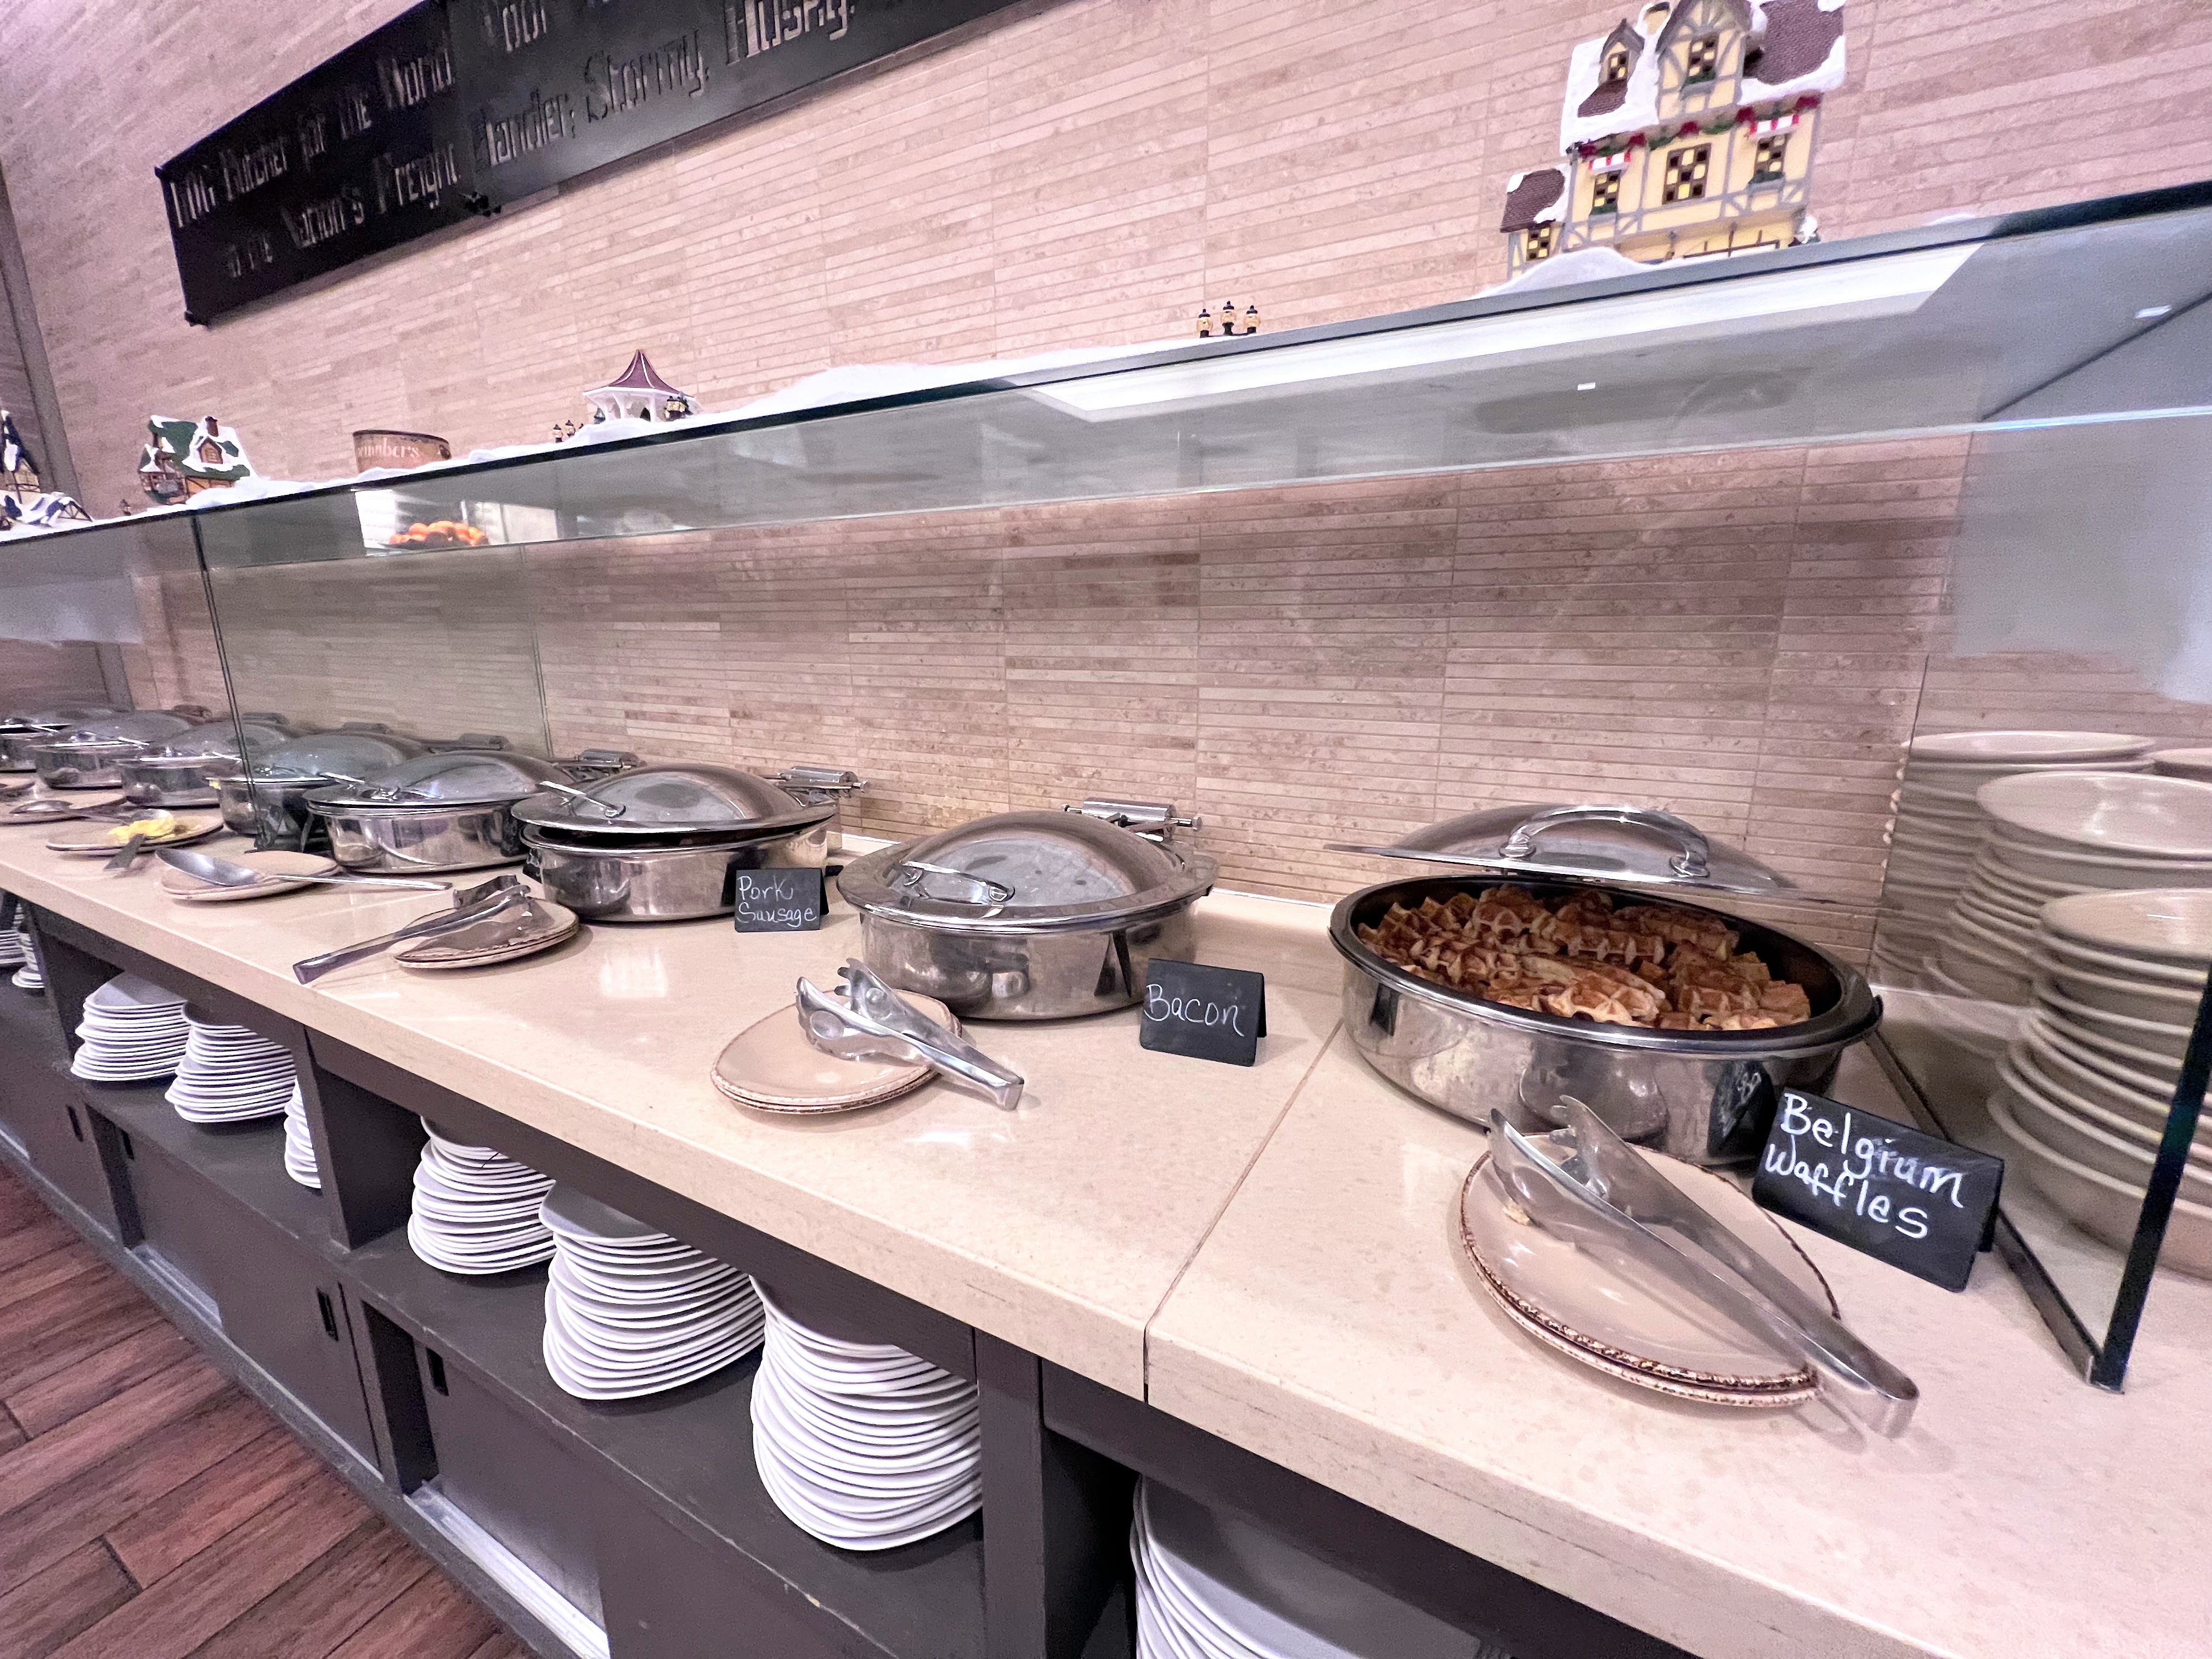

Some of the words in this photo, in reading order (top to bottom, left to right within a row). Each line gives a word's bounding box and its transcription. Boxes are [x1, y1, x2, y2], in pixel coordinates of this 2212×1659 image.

[737, 874, 794, 902] Pork
[736, 901, 817, 928] Sausage
[1143, 983, 1245, 1037] Bacon
[1780, 1092, 1968, 1209] Belgium
